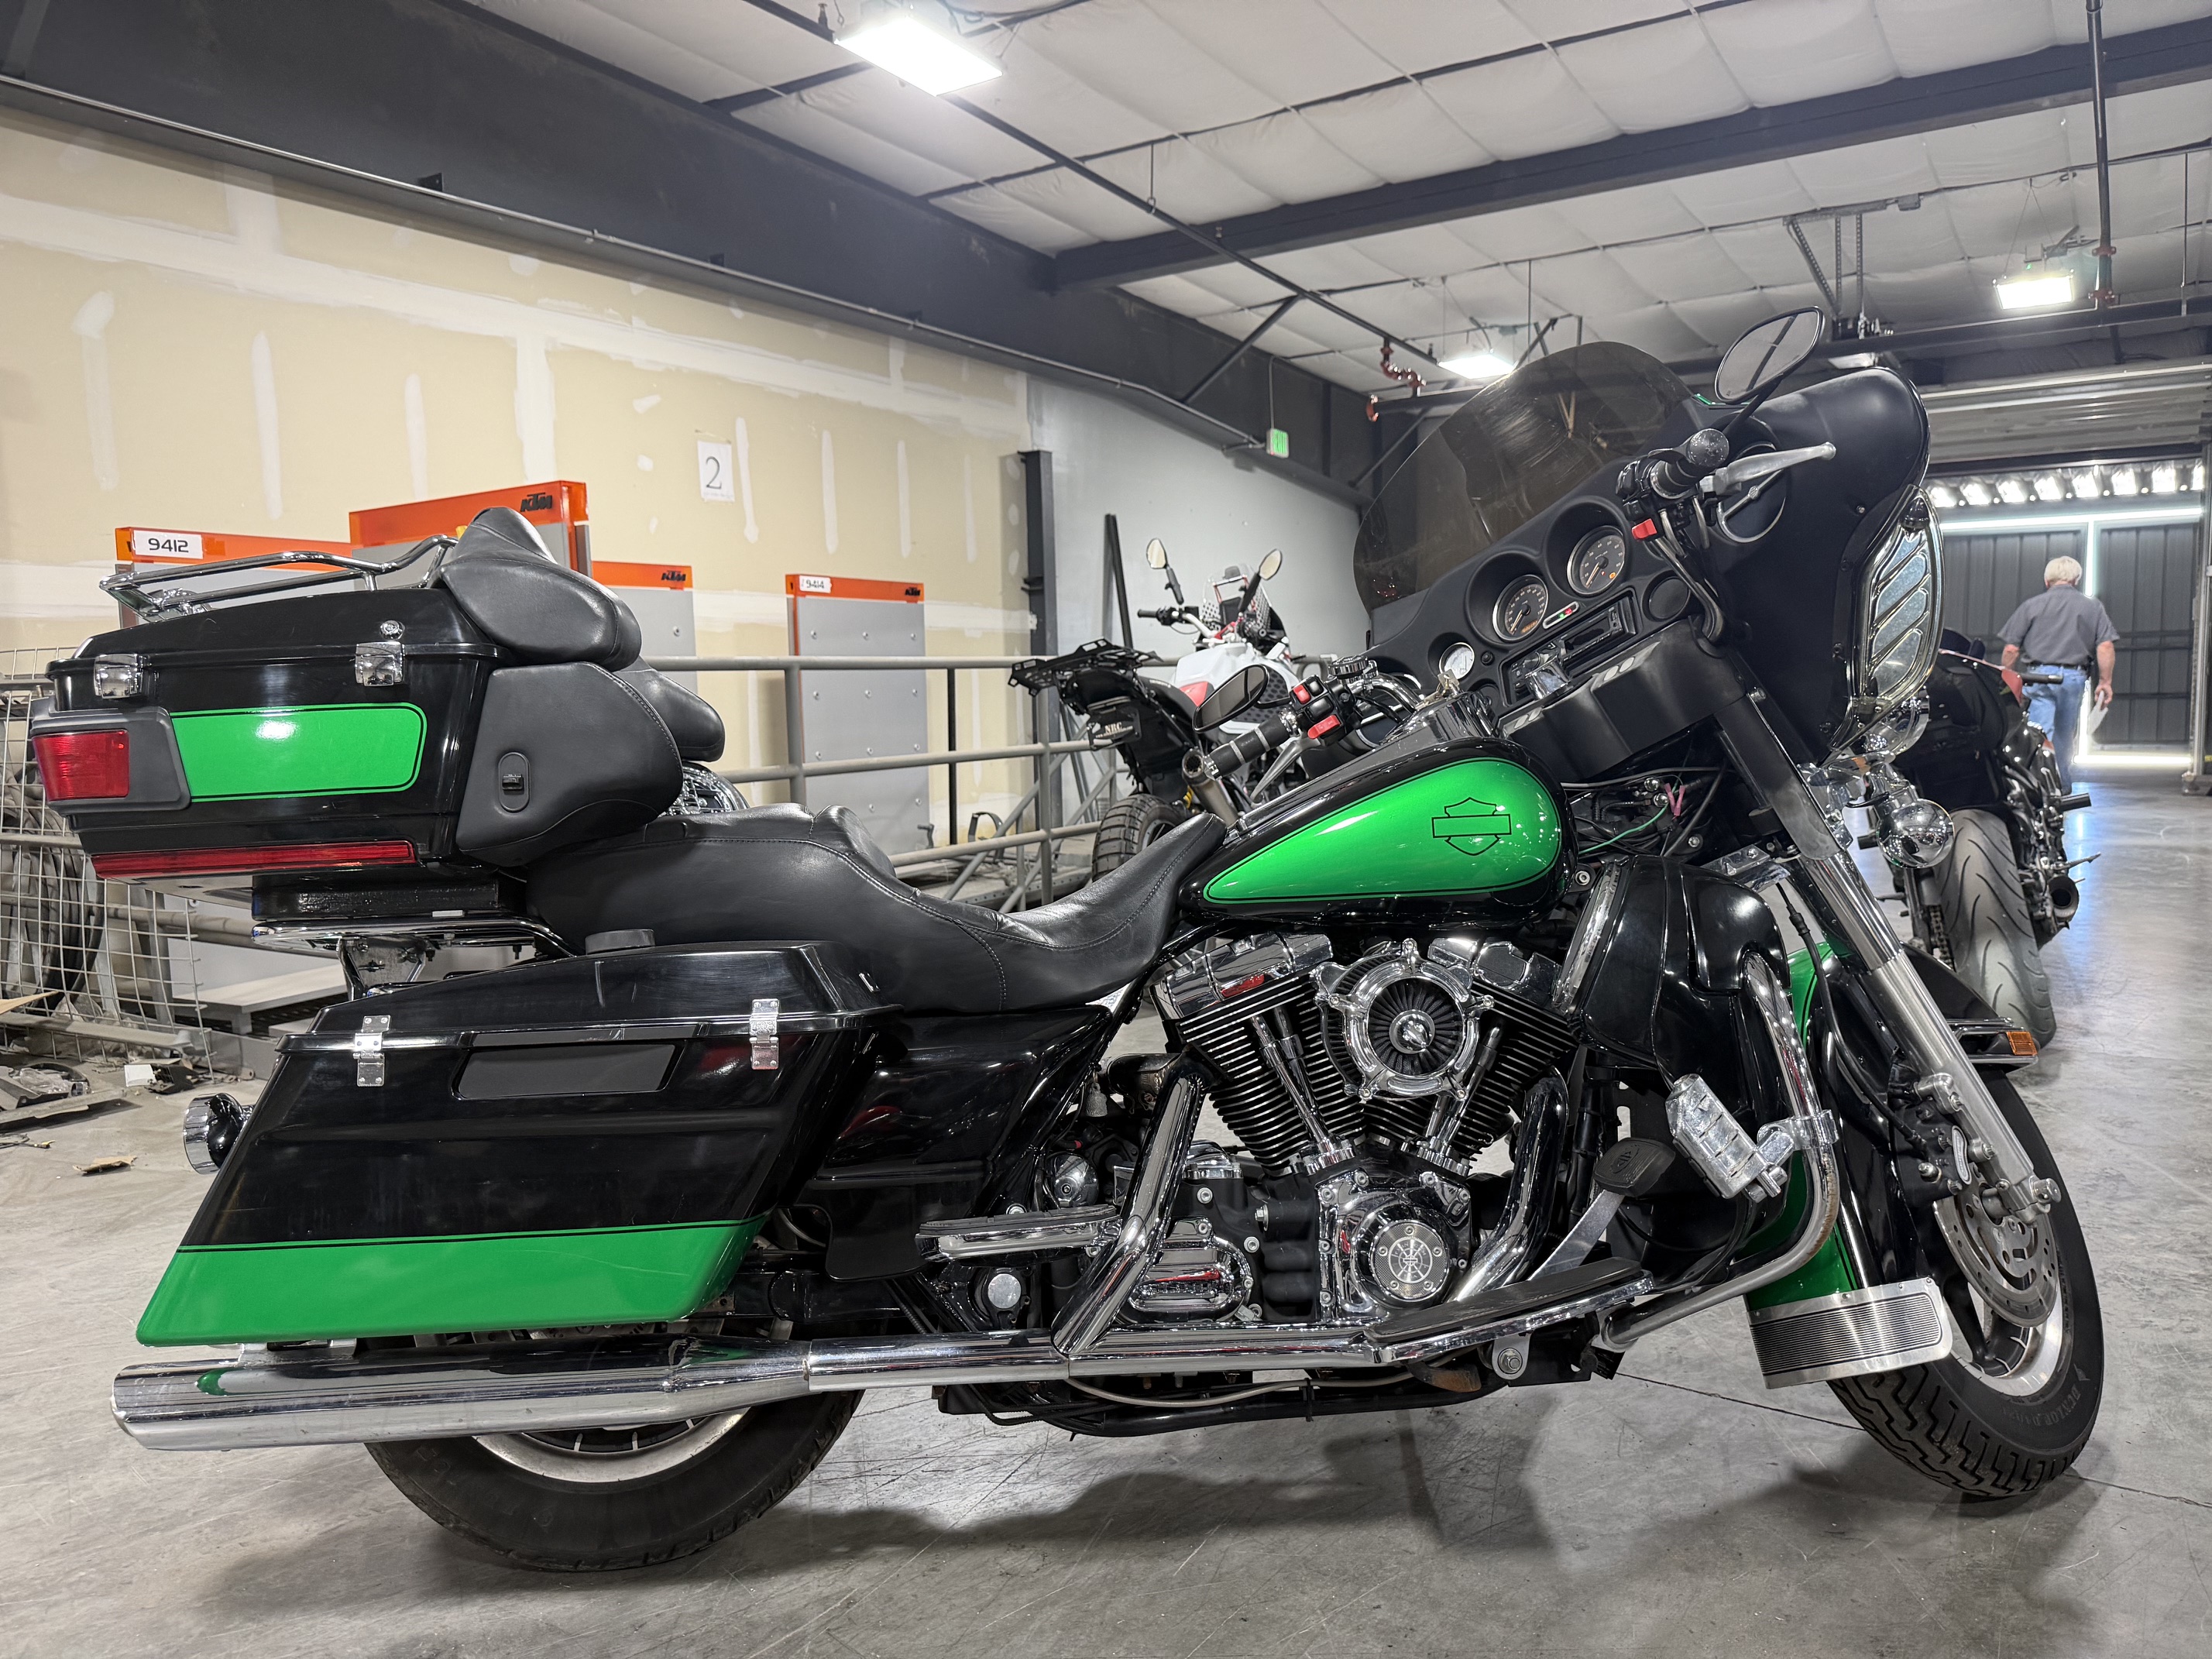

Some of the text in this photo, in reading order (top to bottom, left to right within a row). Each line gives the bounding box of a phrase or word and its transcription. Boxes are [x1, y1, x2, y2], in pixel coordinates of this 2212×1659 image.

[706, 455, 722, 489] 2
[520, 492, 552, 512] KTM
[148, 538, 189, 552] 9412
[661, 570, 686, 582] KTM
[905, 587, 920, 596] KTM
